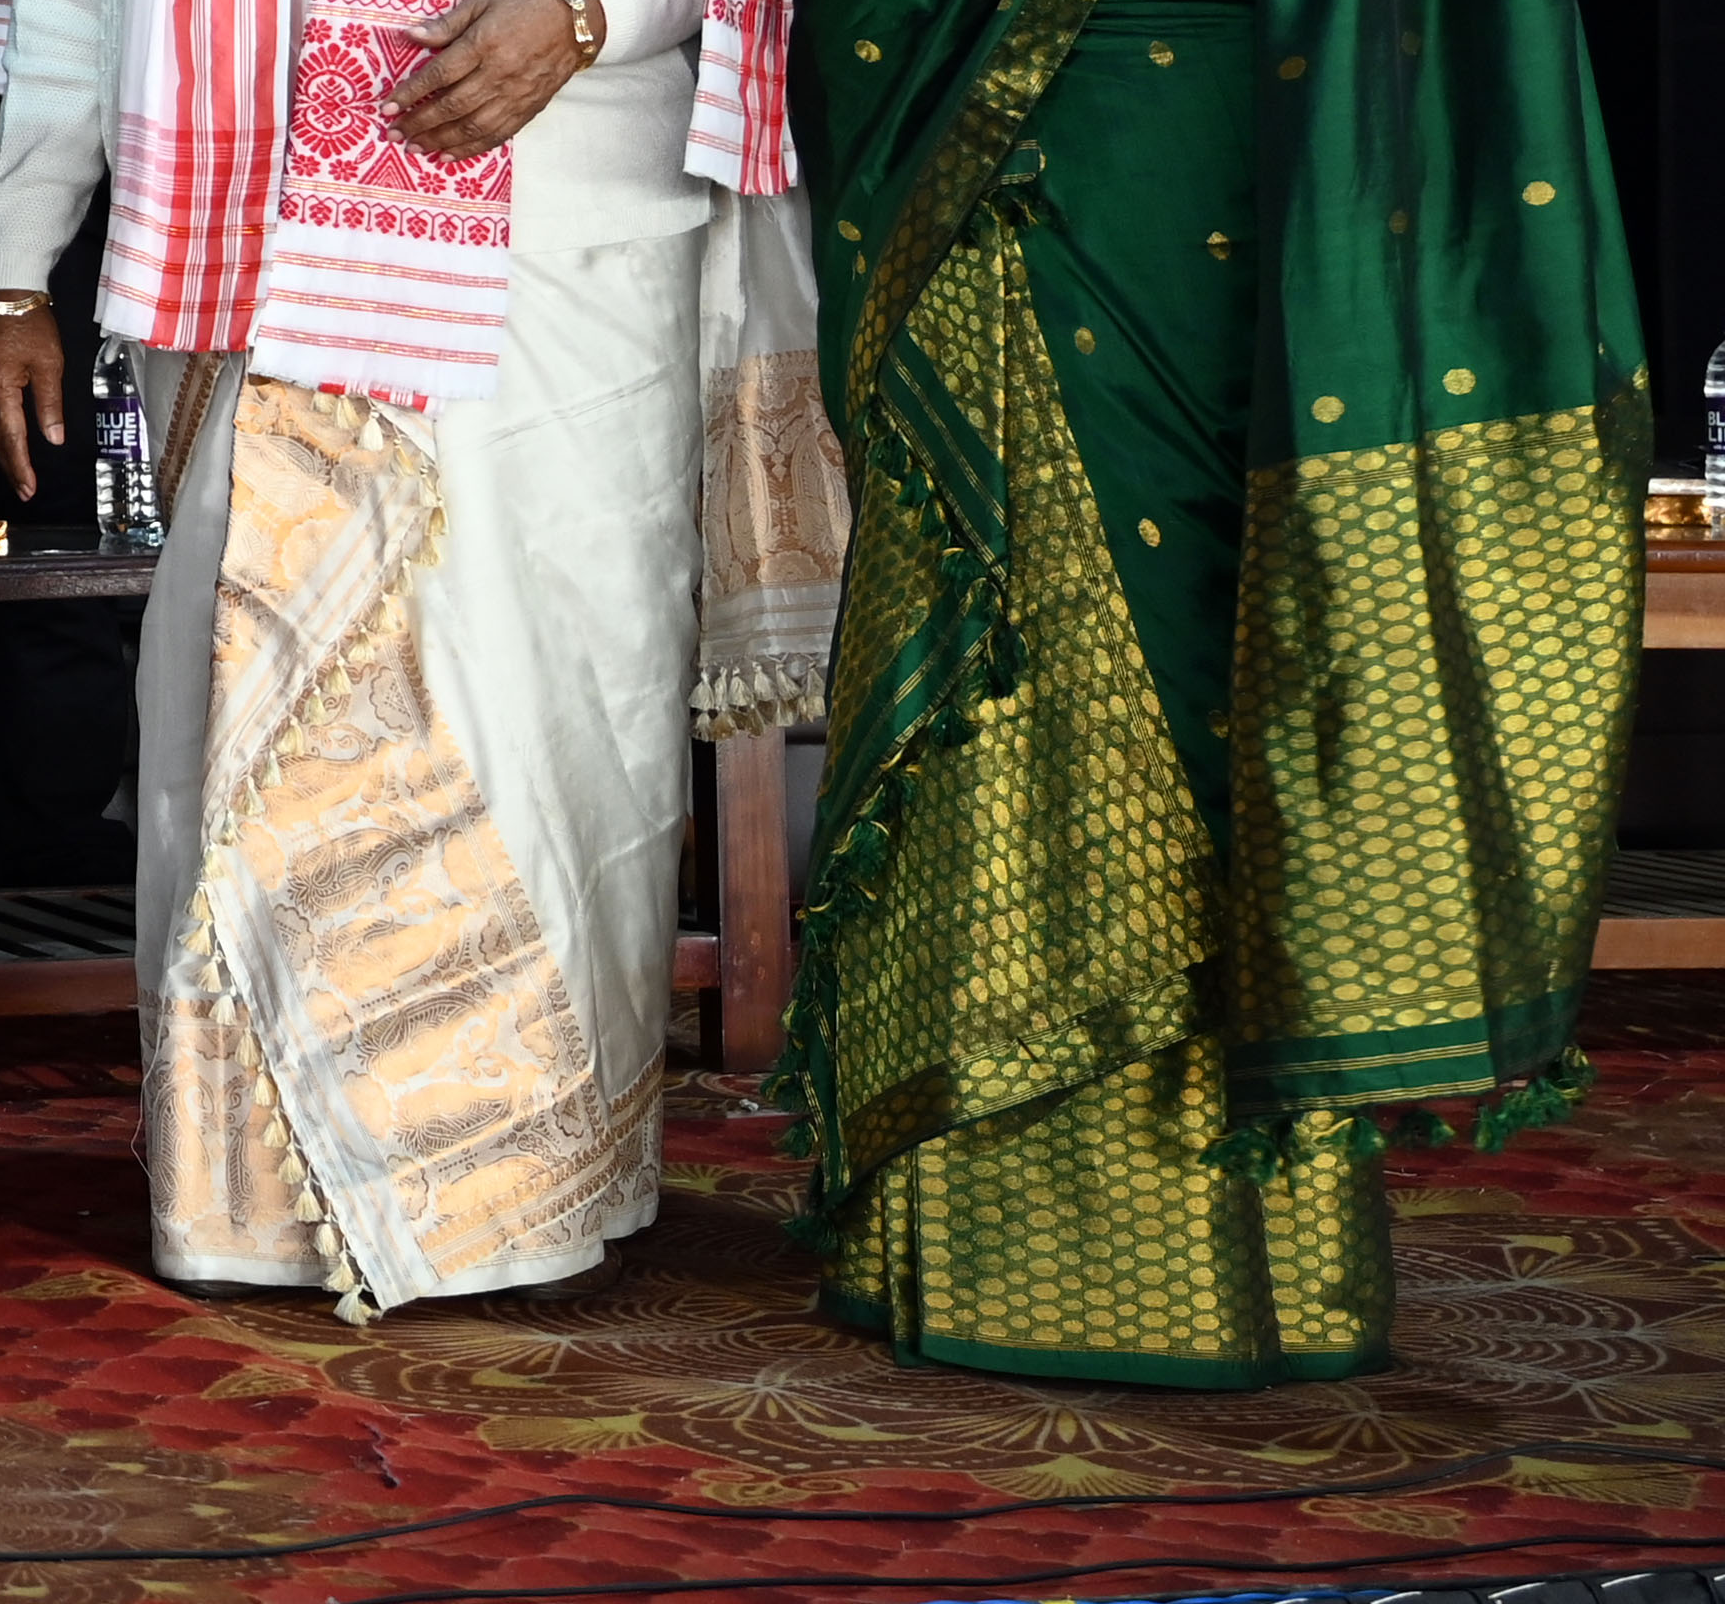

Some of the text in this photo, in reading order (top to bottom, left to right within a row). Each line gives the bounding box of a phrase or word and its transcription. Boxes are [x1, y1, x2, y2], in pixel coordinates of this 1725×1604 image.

[95, 411, 138, 430] BLUE
[1707, 410, 1725, 426] BL
[95, 428, 138, 447] LIFE
[1707, 426, 1725, 443] LI
